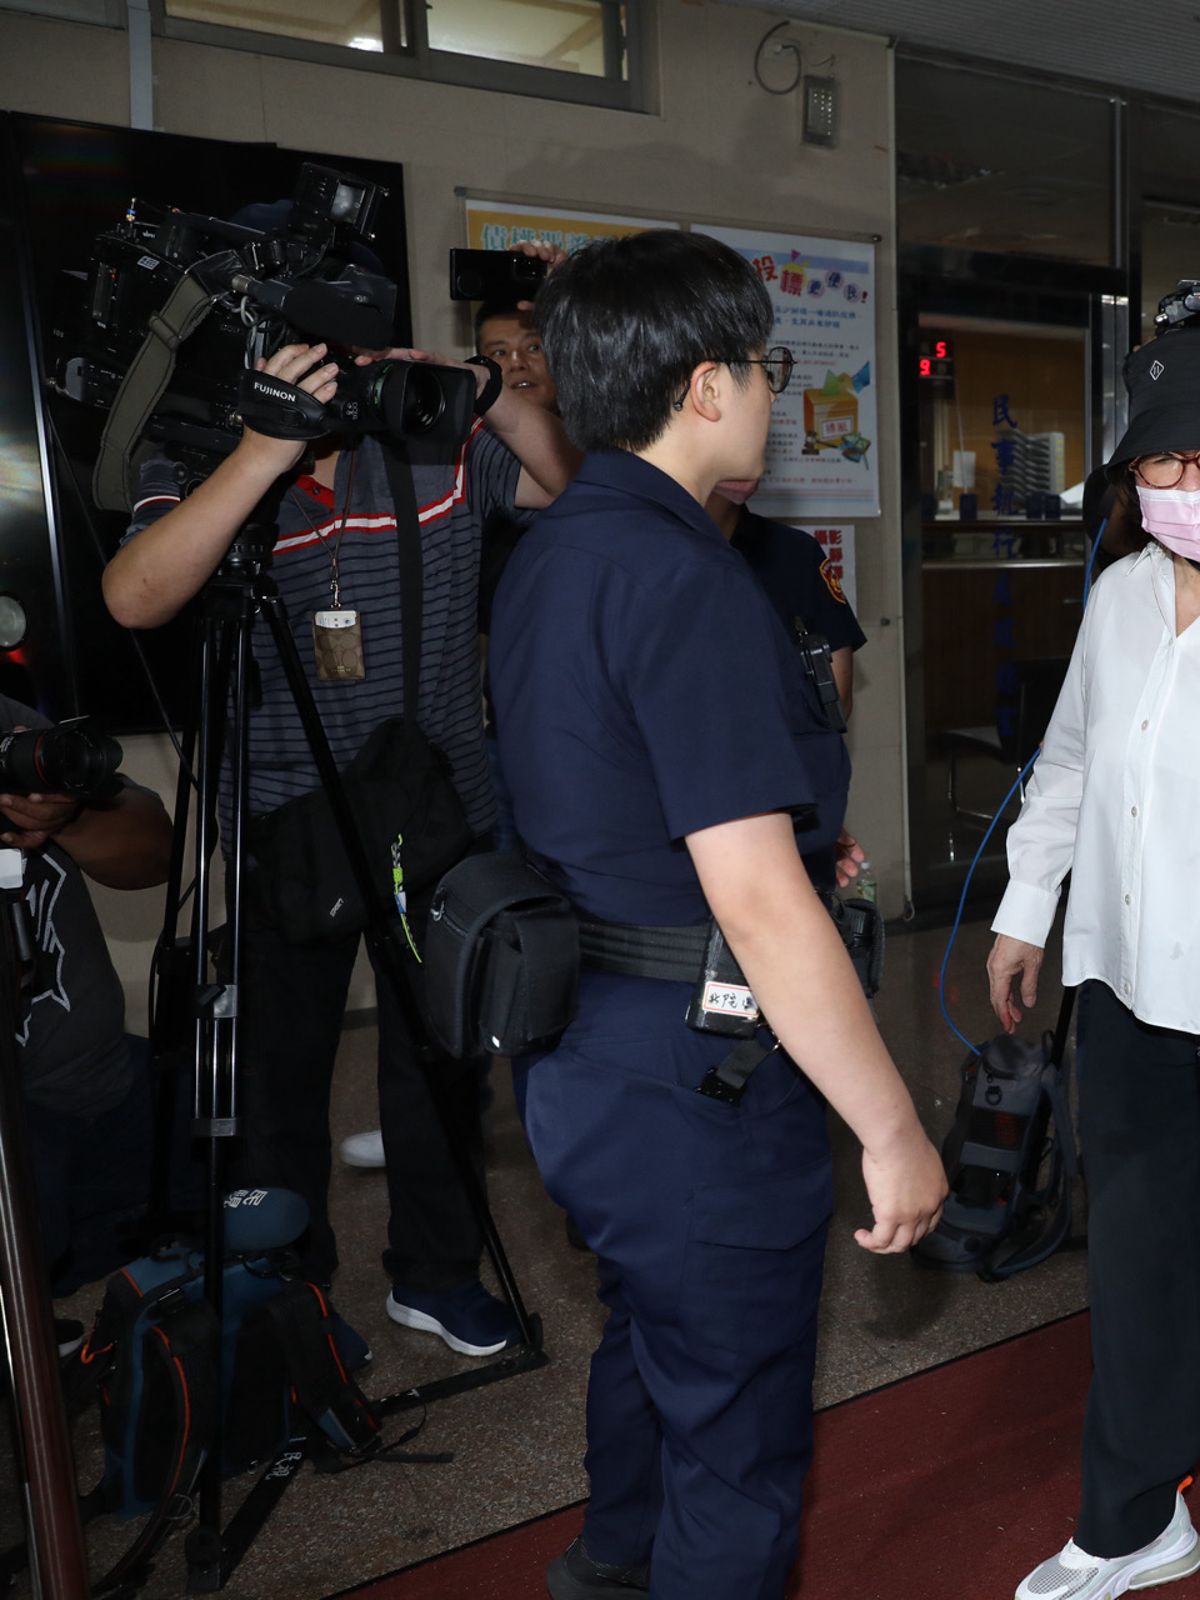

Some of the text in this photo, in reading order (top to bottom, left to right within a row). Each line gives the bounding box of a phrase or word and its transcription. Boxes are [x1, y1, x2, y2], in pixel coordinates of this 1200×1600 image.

[936, 341, 947, 358] 5
[920, 359, 931, 376] 9
[254, 381, 296, 402] FUJINON
